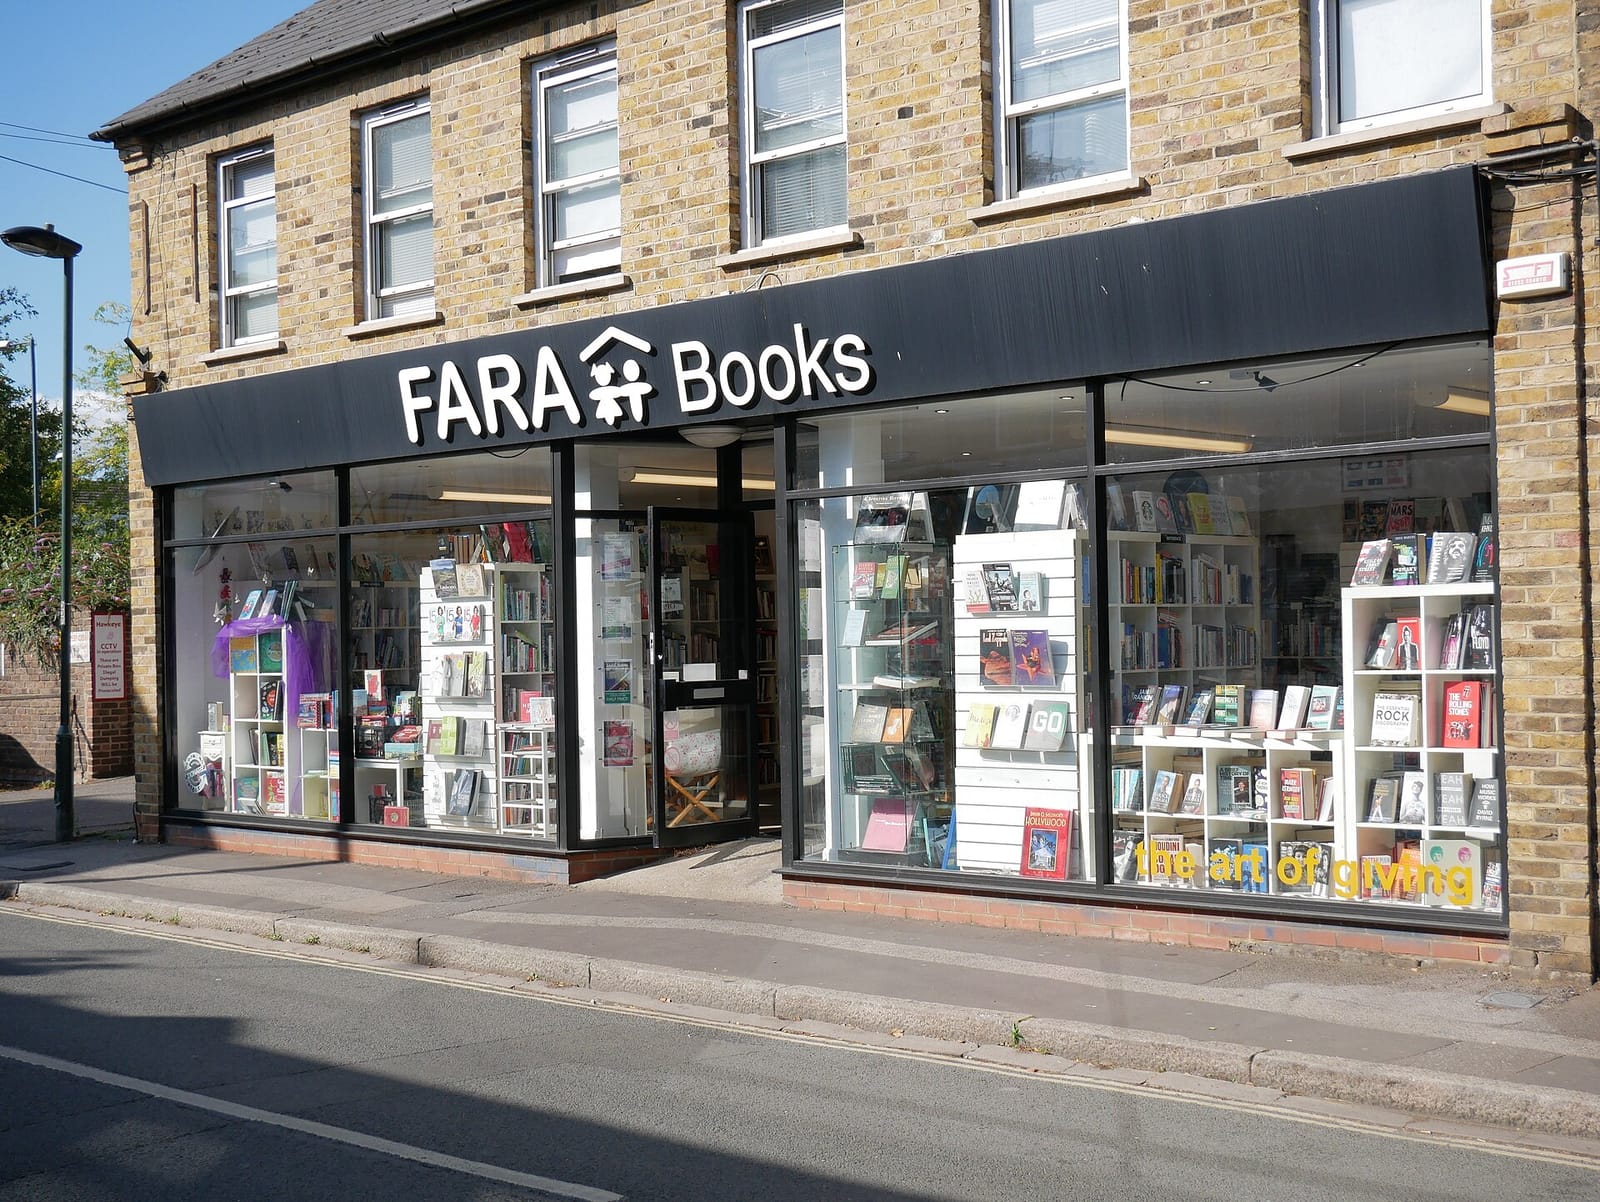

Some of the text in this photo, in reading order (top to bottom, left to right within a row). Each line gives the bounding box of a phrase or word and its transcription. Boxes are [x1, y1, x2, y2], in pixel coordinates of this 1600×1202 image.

[398, 322, 871, 444] FARA Books
[1472, 637, 1489, 649] FLOYD
[1448, 692, 1460, 700] THE
[1448, 700, 1472, 708] ROLLING
[1376, 709, 1409, 721] ROCK
[1448, 707, 1469, 716] STONES
[1033, 710, 1063, 733] GO
[1435, 774, 1464, 784] YEAH
[1435, 794, 1464, 803] YEAH
[1025, 816, 1066, 827] HOLLYWOOD
[1435, 815, 1466, 825] YEAH
[1135, 839, 1196, 879] the
[1209, 847, 1265, 884] art
[1277, 846, 1320, 886] of
[1332, 853, 1473, 906] giving
